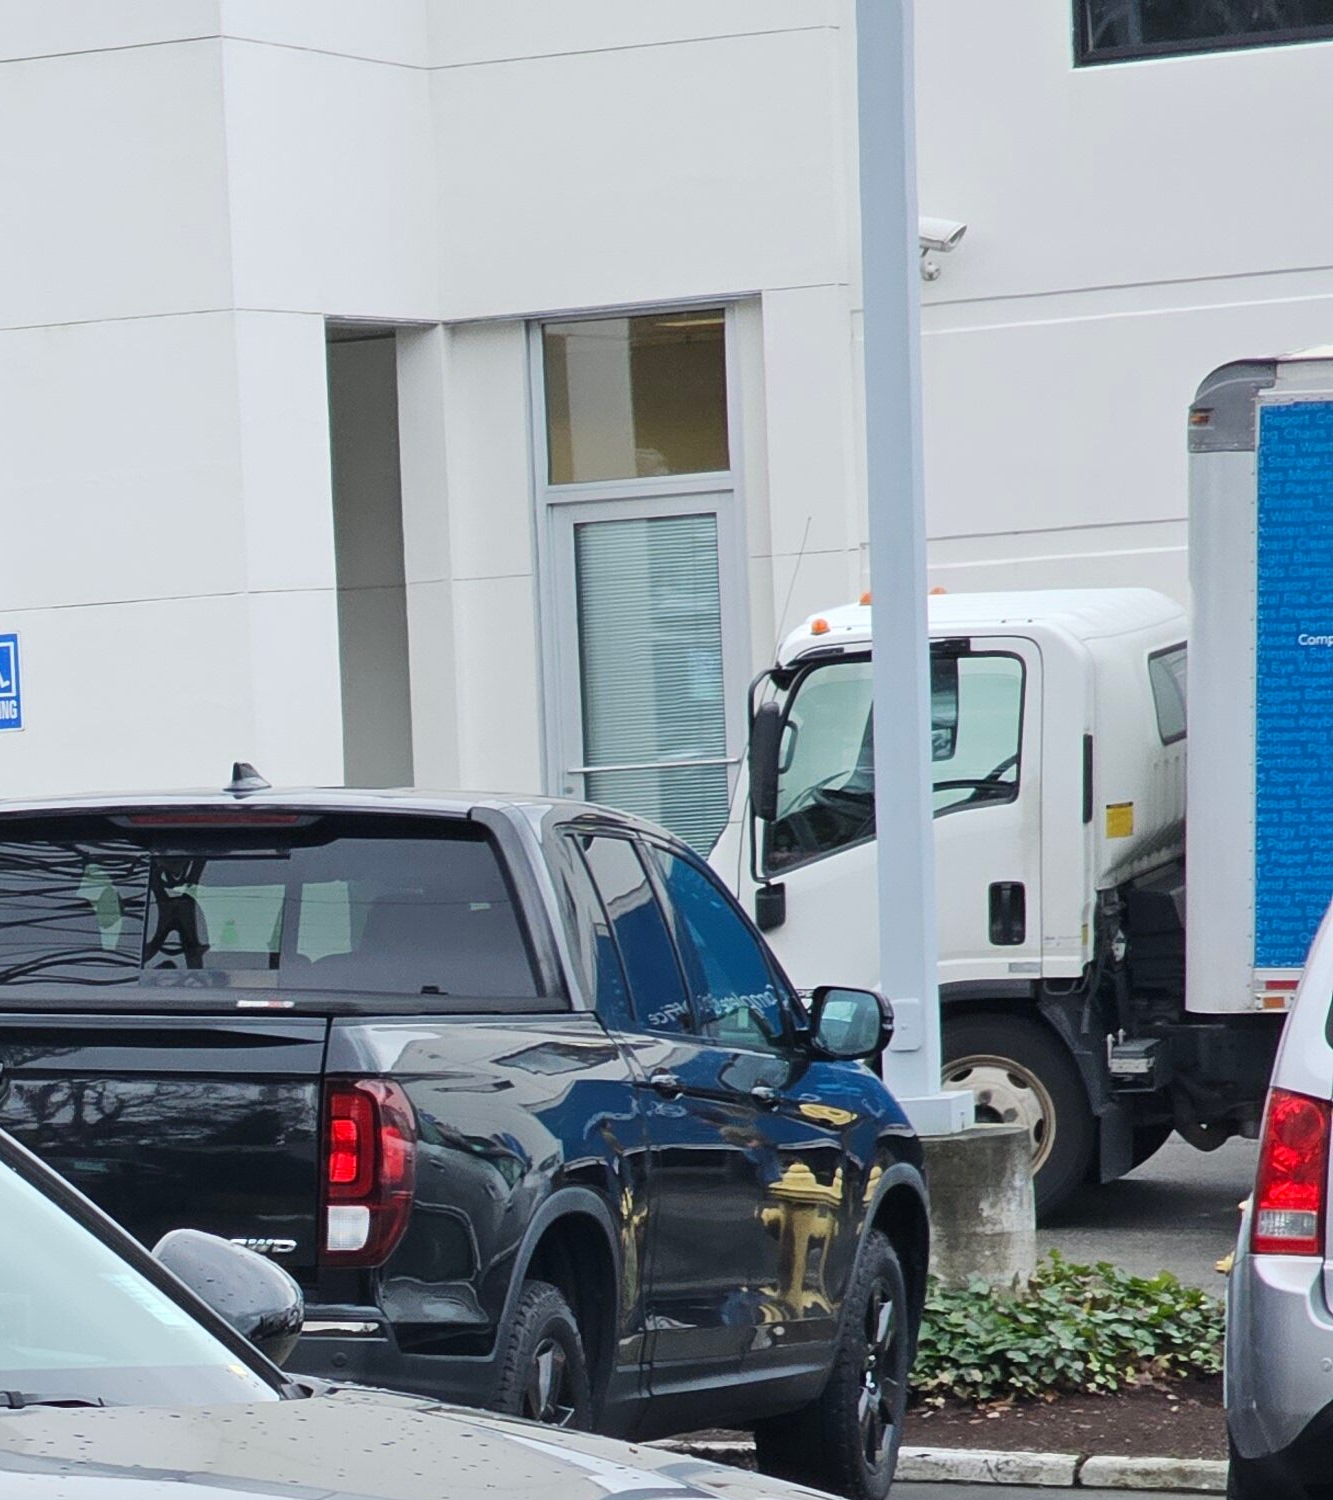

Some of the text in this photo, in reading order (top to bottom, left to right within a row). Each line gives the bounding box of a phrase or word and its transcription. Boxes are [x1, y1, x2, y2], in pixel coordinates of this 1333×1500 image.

[1264, 414, 1309, 428] Report
[1284, 428, 1326, 439] Chairs
[1268, 455, 1320, 469] Storage
[1282, 810, 1308, 822] Box
[1267, 838, 1306, 851] Paper
[1270, 851, 1309, 865] Paper
